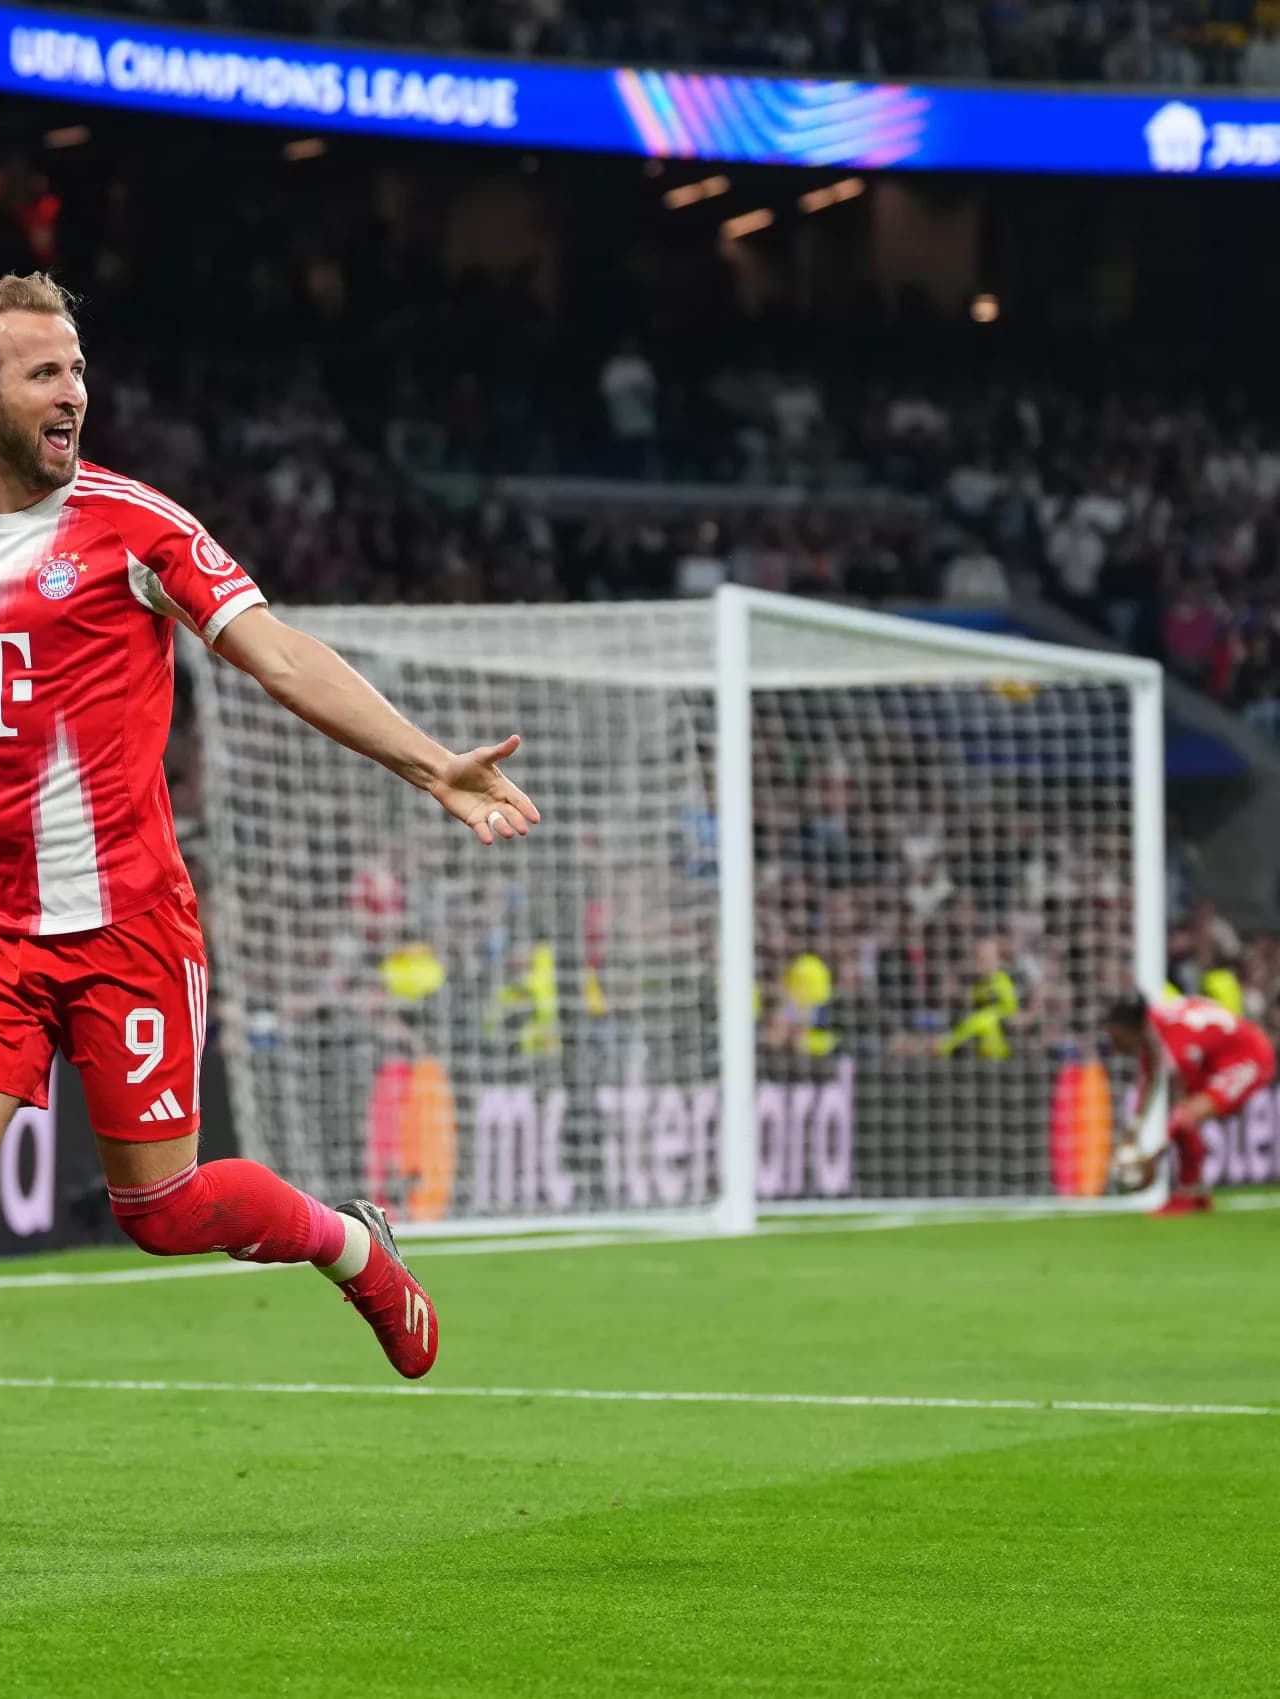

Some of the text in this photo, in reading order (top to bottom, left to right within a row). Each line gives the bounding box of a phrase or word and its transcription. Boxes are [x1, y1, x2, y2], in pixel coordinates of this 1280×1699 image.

[9, 27, 518, 129] UEFA CHAMPIONS LEAGUE
[51, 562, 75, 578] BAYERN
[125, 1008, 165, 1084] 9
